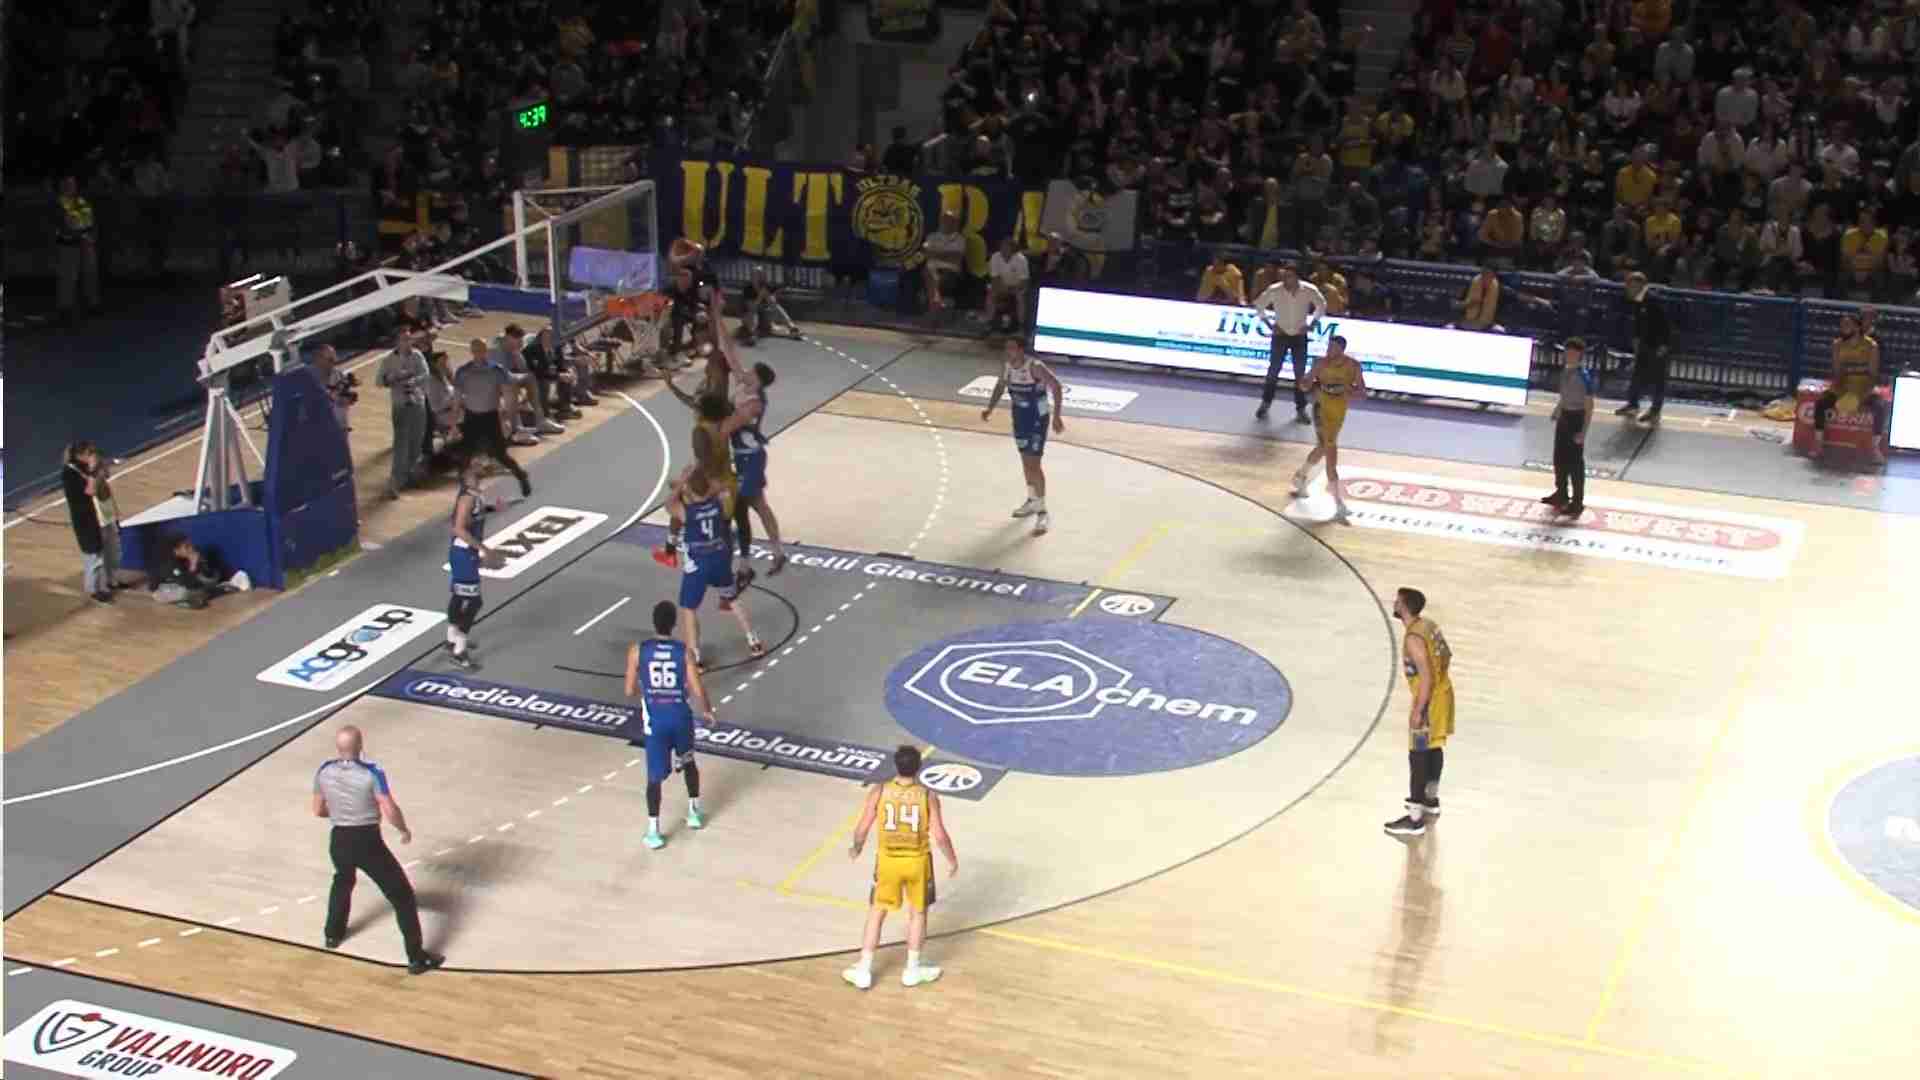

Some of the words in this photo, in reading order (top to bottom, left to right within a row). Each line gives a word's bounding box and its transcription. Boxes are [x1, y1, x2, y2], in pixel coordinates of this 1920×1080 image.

[519, 104, 547, 128] 4:39
[701, 518, 713, 539] 4
[733, 543, 864, 571] Frtelli
[863, 562, 1028, 596] Giacomel
[648, 661, 677, 688] 66
[957, 660, 1076, 698] ELA
[1095, 686, 1257, 725] chem
[415, 679, 629, 726] mediolanum
[694, 727, 882, 770] ediolanum
[883, 803, 920, 832] 14
[77, 1048, 165, 1078] GROUP
[105, 1026, 275, 1080] VALANDRO
